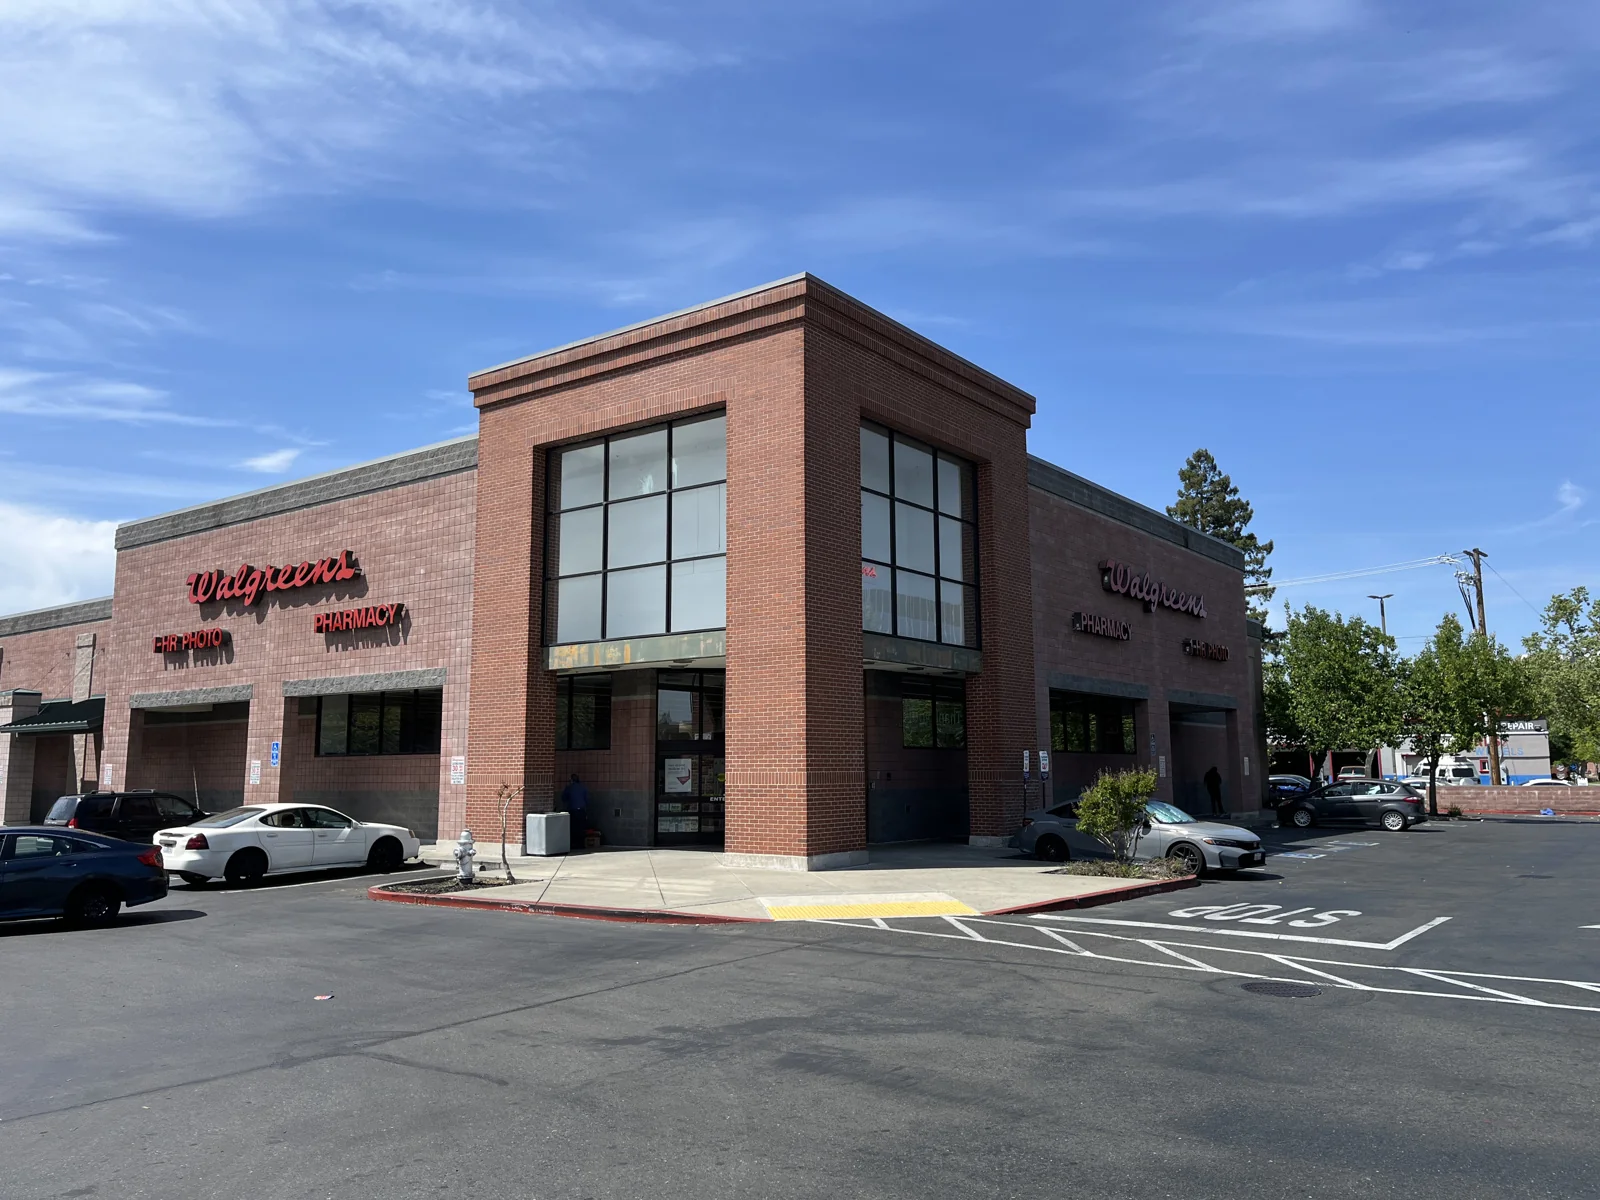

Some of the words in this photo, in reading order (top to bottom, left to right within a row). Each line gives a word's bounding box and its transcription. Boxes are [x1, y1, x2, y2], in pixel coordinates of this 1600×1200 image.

[186, 549, 355, 606] Walgreens
[1106, 558, 1208, 618] Walgreens
[314, 603, 399, 634] PHARMACY
[1081, 612, 1133, 641] PHARMACY
[152, 633, 177, 654] 1-HR
[182, 627, 223, 650] PHOTO
[1208, 643, 1230, 661] PHOTO
[1168, 903, 1363, 928] STOP
